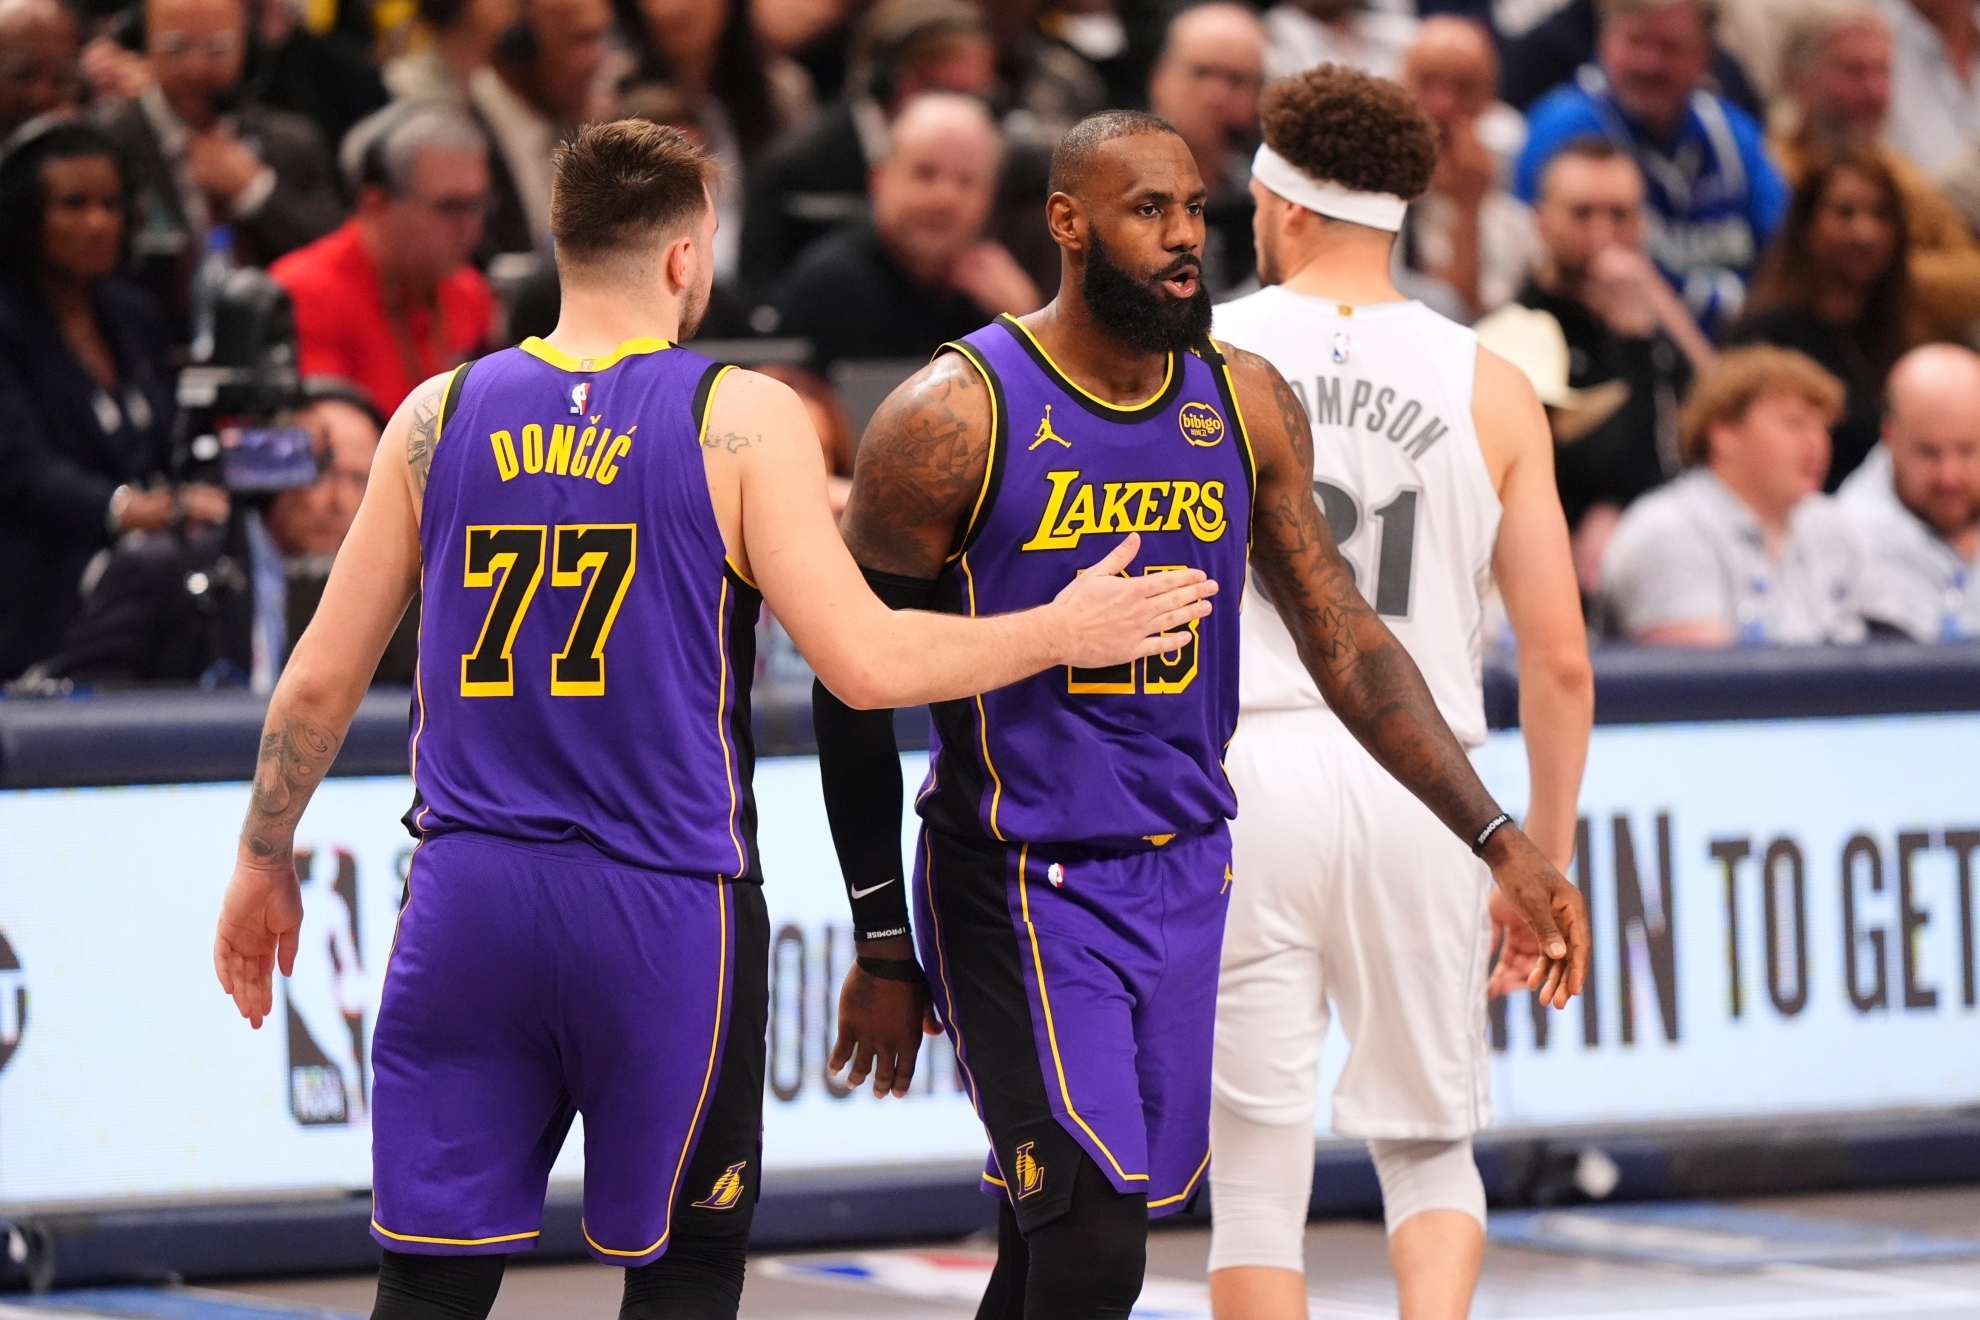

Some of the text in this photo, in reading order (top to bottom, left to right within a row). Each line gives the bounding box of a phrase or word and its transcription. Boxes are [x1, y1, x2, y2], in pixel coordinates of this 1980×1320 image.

[490, 415, 637, 485] DONČIĆ
[1182, 412, 1221, 434] bibigo
[1289, 375, 1449, 460] OMPSON
[1021, 469, 1228, 552] LAKERS
[460, 523, 637, 697] 77
[866, 927, 903, 939] PROMISE
[1490, 810, 1980, 1050] IN TO GET
